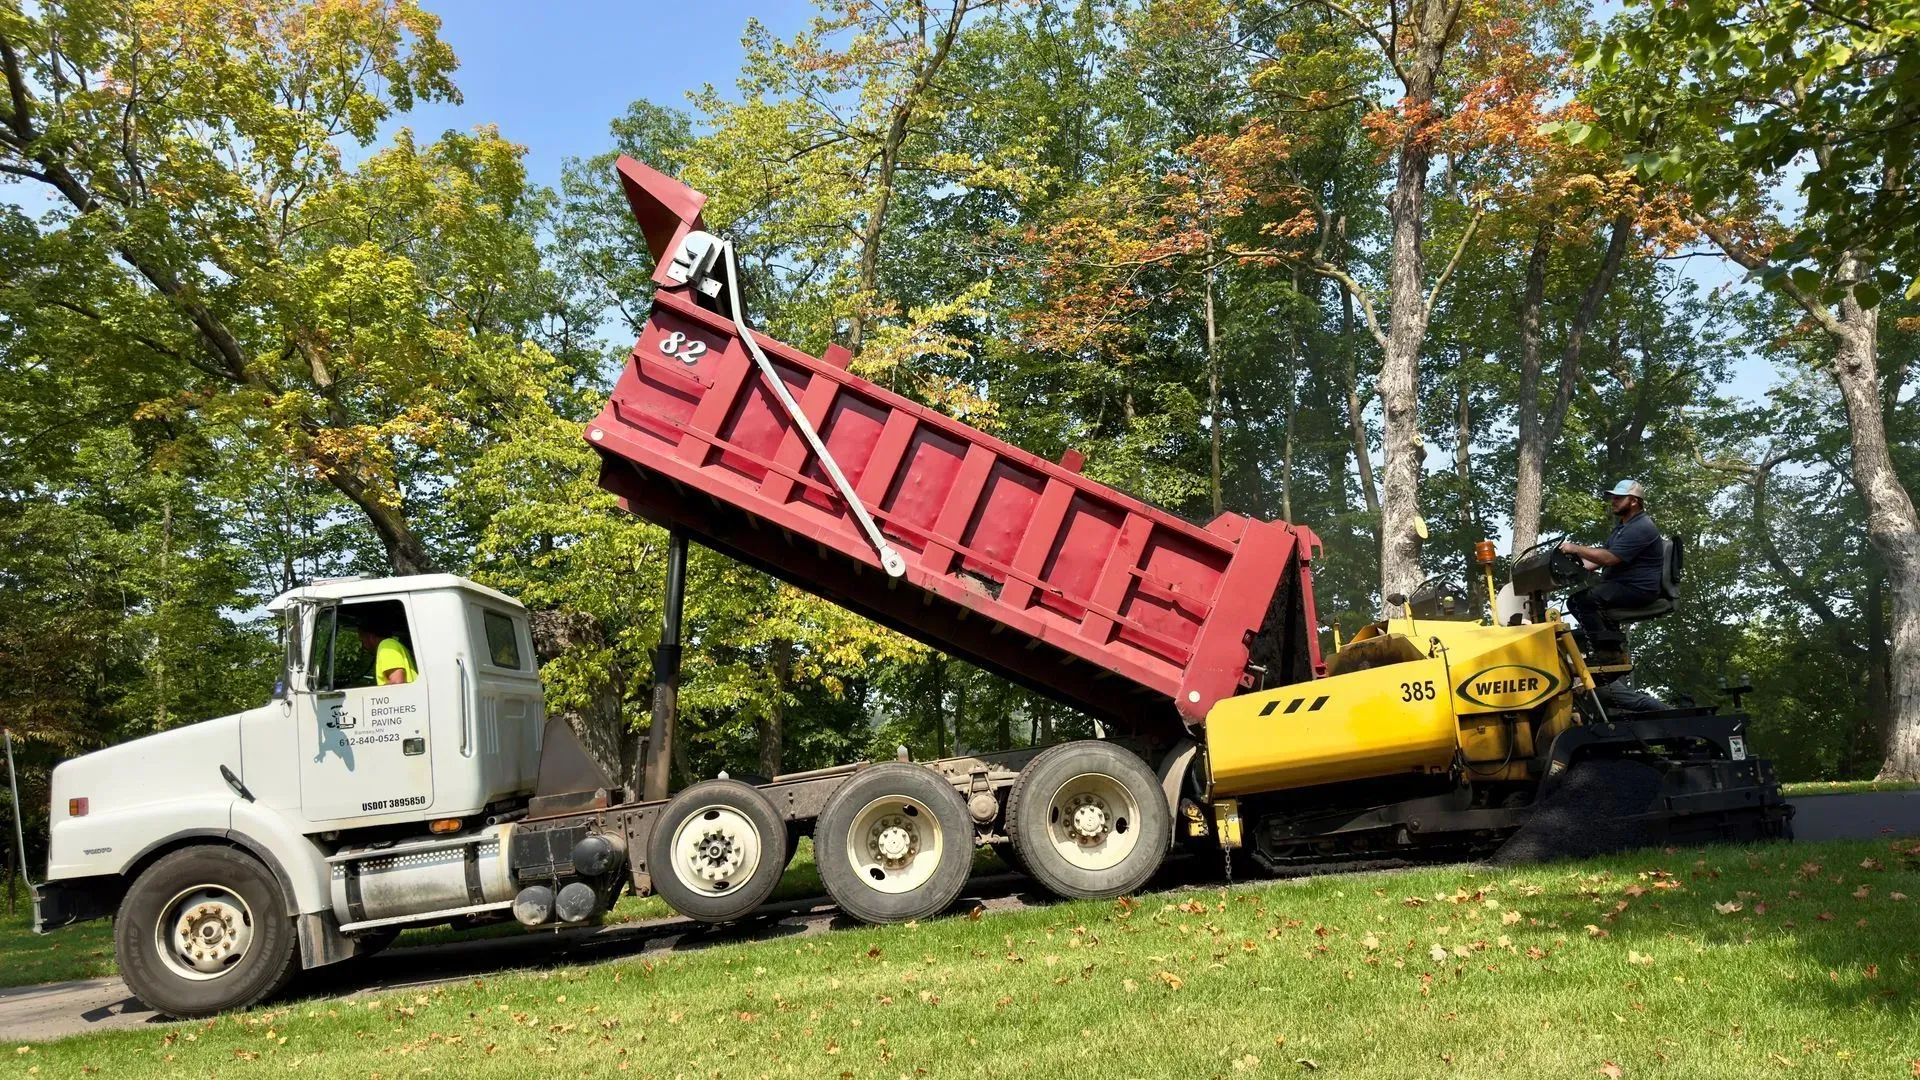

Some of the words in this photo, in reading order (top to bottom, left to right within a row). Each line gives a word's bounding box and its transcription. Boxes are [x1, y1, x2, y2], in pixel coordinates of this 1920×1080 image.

[659, 331, 708, 365] 82
[1400, 680, 1436, 702] 385
[1476, 677, 1539, 696] WEILER
[371, 697, 389, 705] TWO
[371, 705, 416, 716] BROTHERS
[371, 717, 402, 728] PAVING
[339, 733, 400, 747] 612-840-0523
[362, 800, 388, 811] USDOT
[389, 796, 426, 809] 3895850
